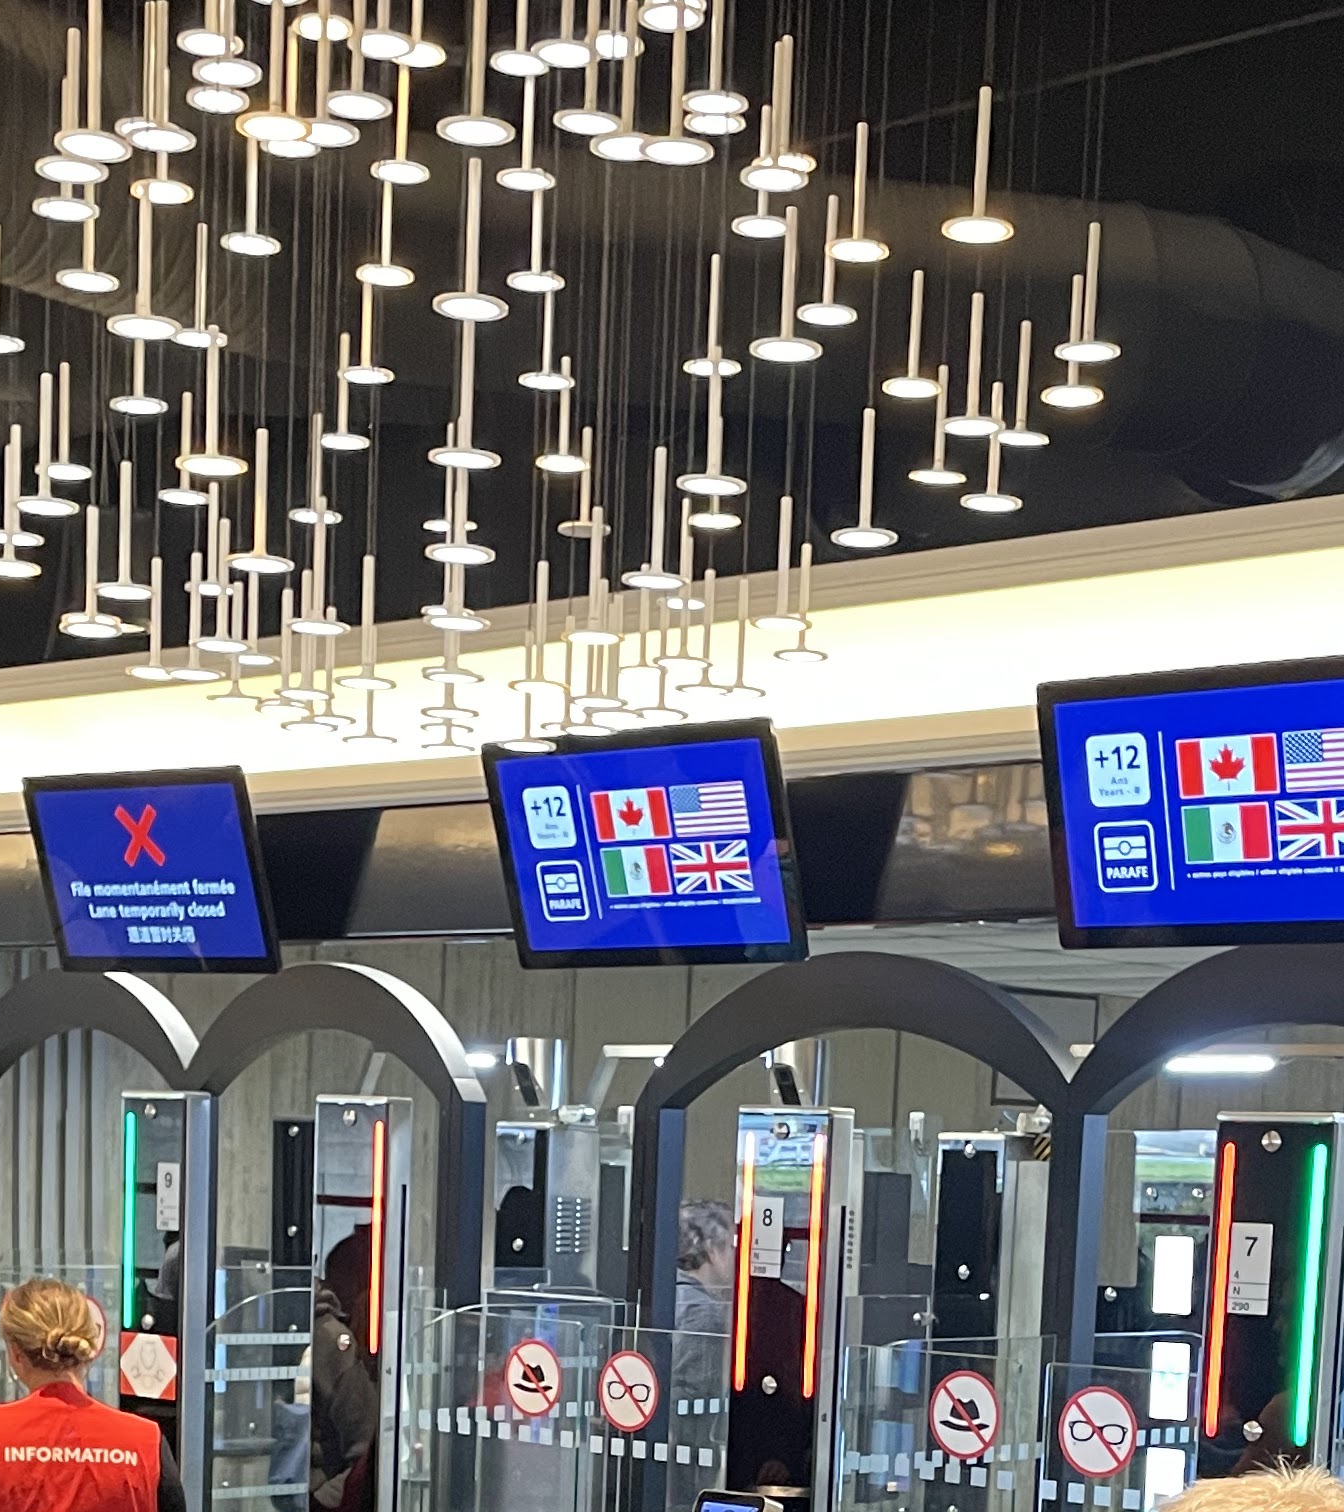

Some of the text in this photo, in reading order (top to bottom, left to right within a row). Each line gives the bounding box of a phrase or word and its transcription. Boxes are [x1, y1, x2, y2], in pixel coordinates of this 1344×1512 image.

[1094, 745, 1141, 770] +12
[531, 796, 567, 818] +12
[1106, 865, 1149, 880] PARAFE
[70, 878, 236, 897] File momentanément fermée
[88, 900, 226, 921] Lane temporarily closed
[164, 1172, 173, 1188] 9
[762, 1208, 773, 1227] 8
[1244, 1236, 1258, 1257] 7
[1232, 1286, 1241, 1295] N
[4, 1446, 138, 1467] INFORMATION
